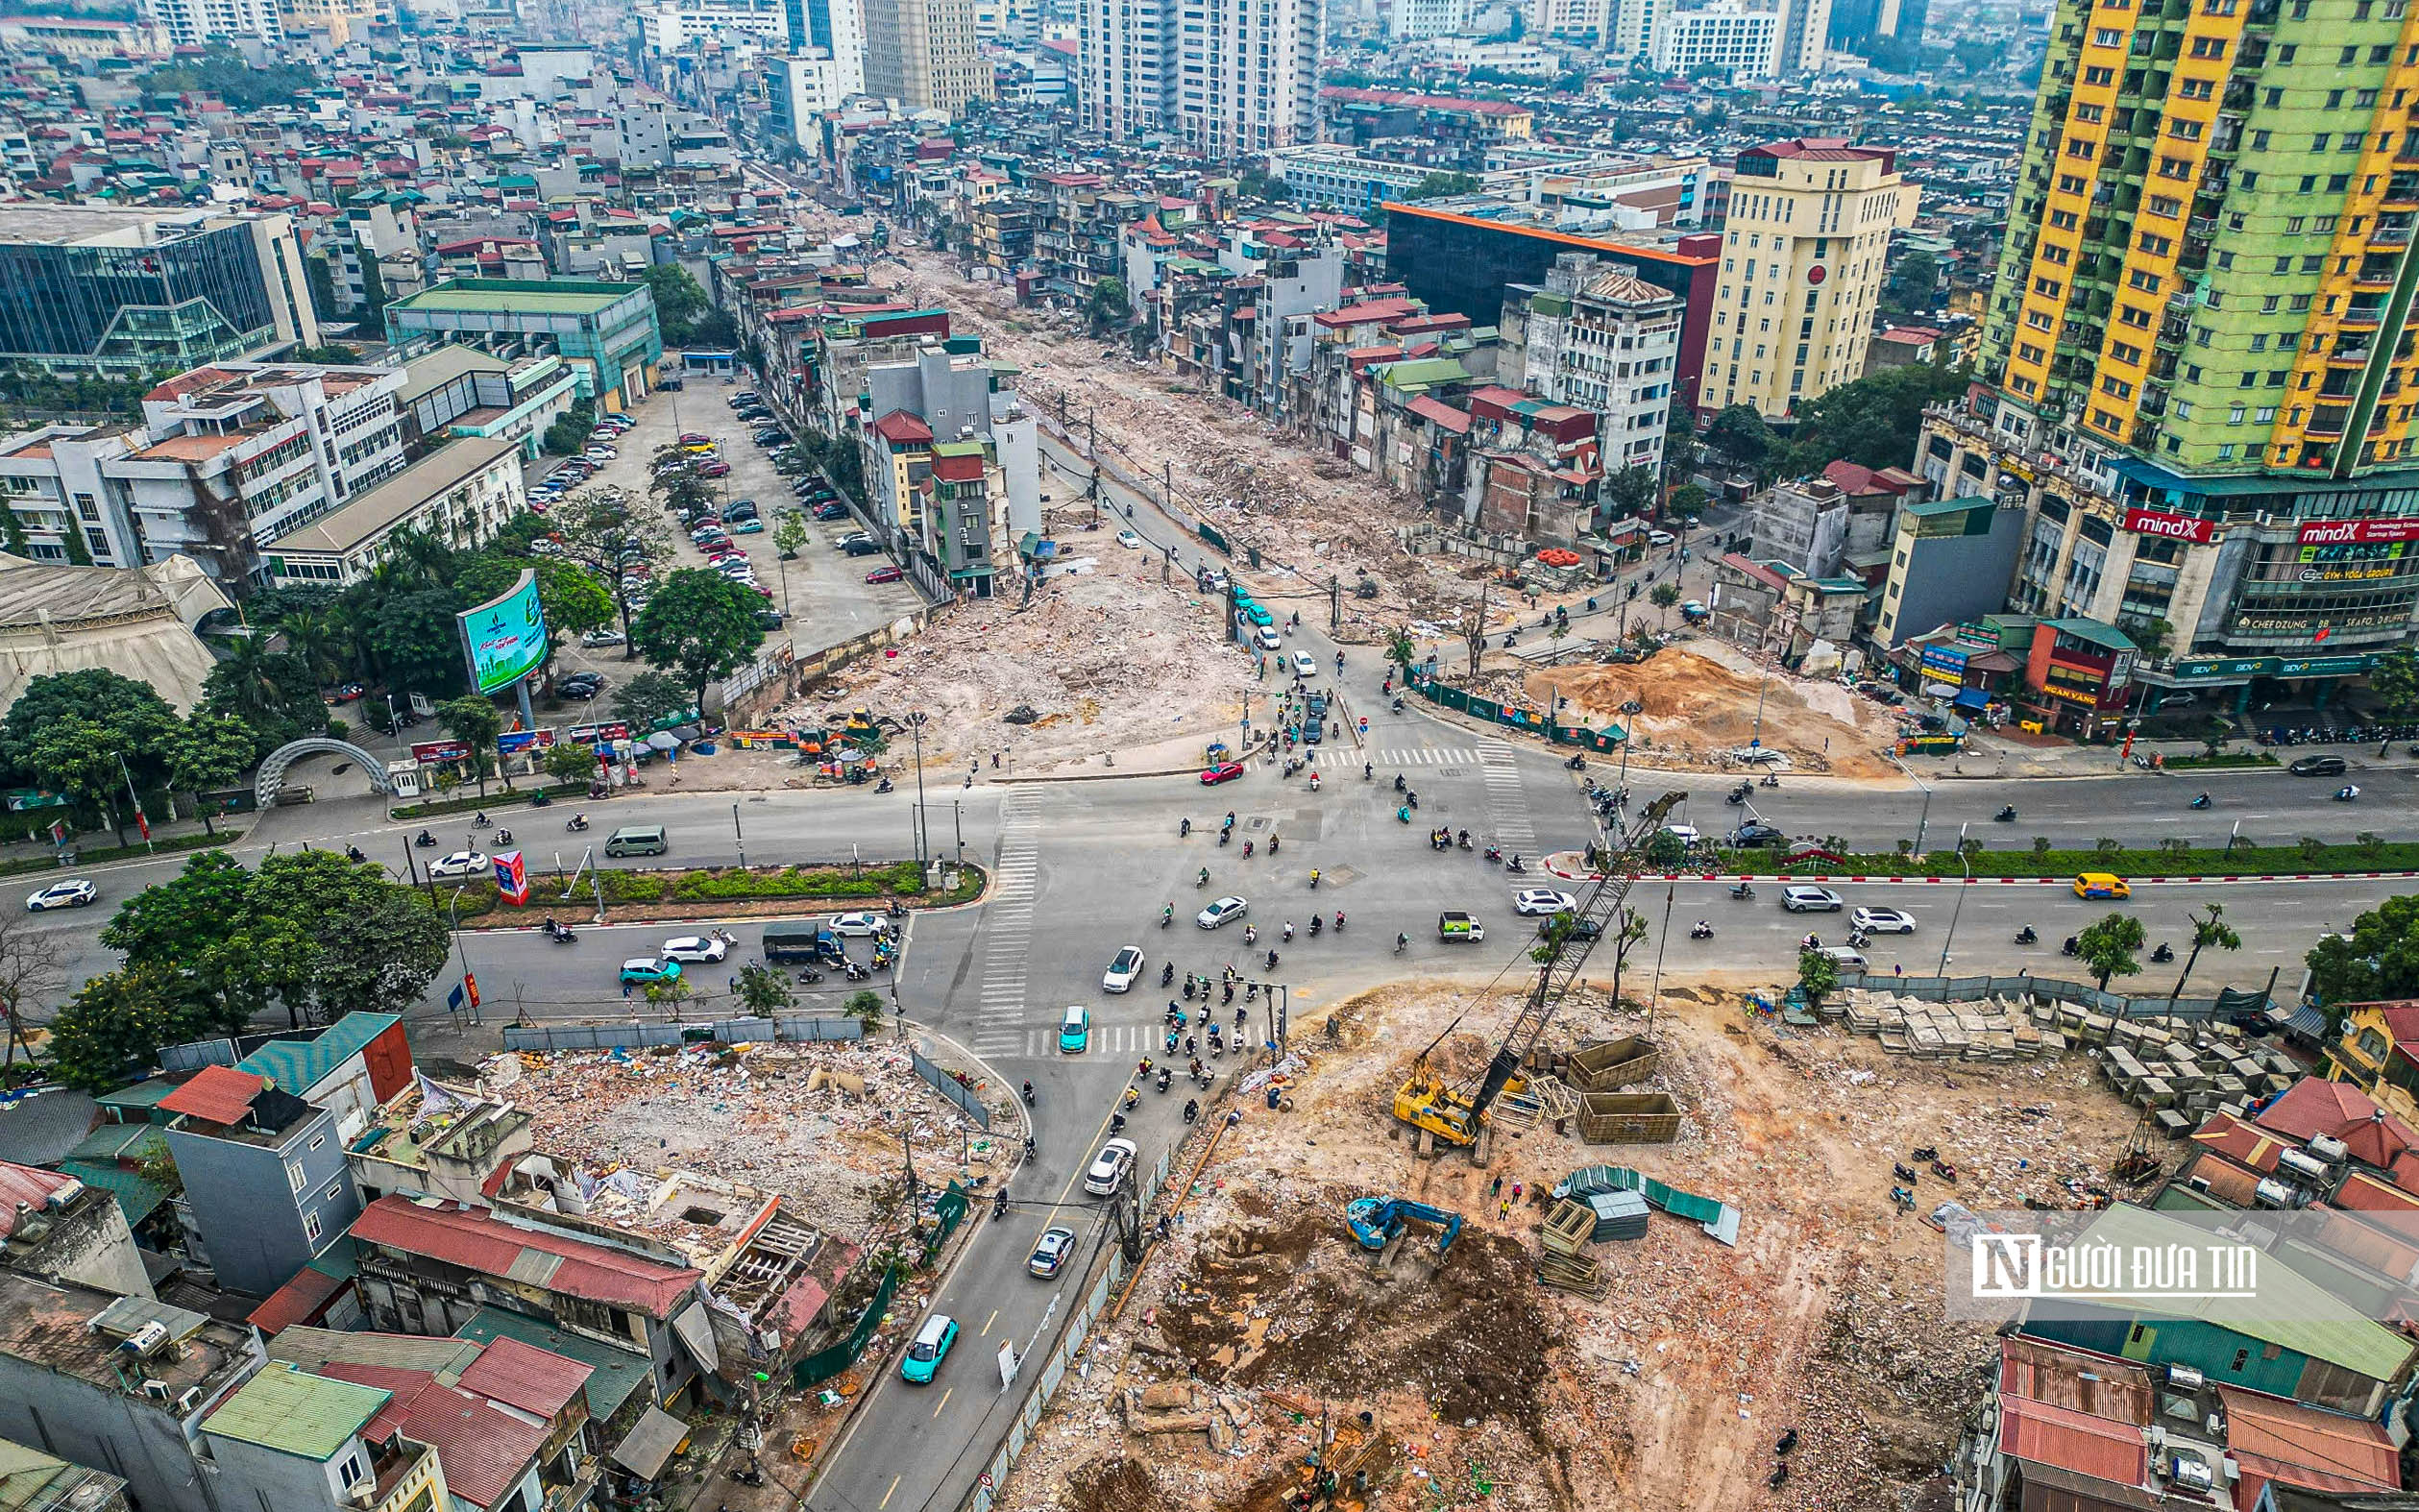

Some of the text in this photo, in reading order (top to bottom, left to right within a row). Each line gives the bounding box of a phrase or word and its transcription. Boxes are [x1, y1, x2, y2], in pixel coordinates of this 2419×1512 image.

[2138, 517, 2201, 538] mindX
[2303, 523, 2359, 541] mindX
[2251, 620, 2308, 629] CHEF DZUNG
